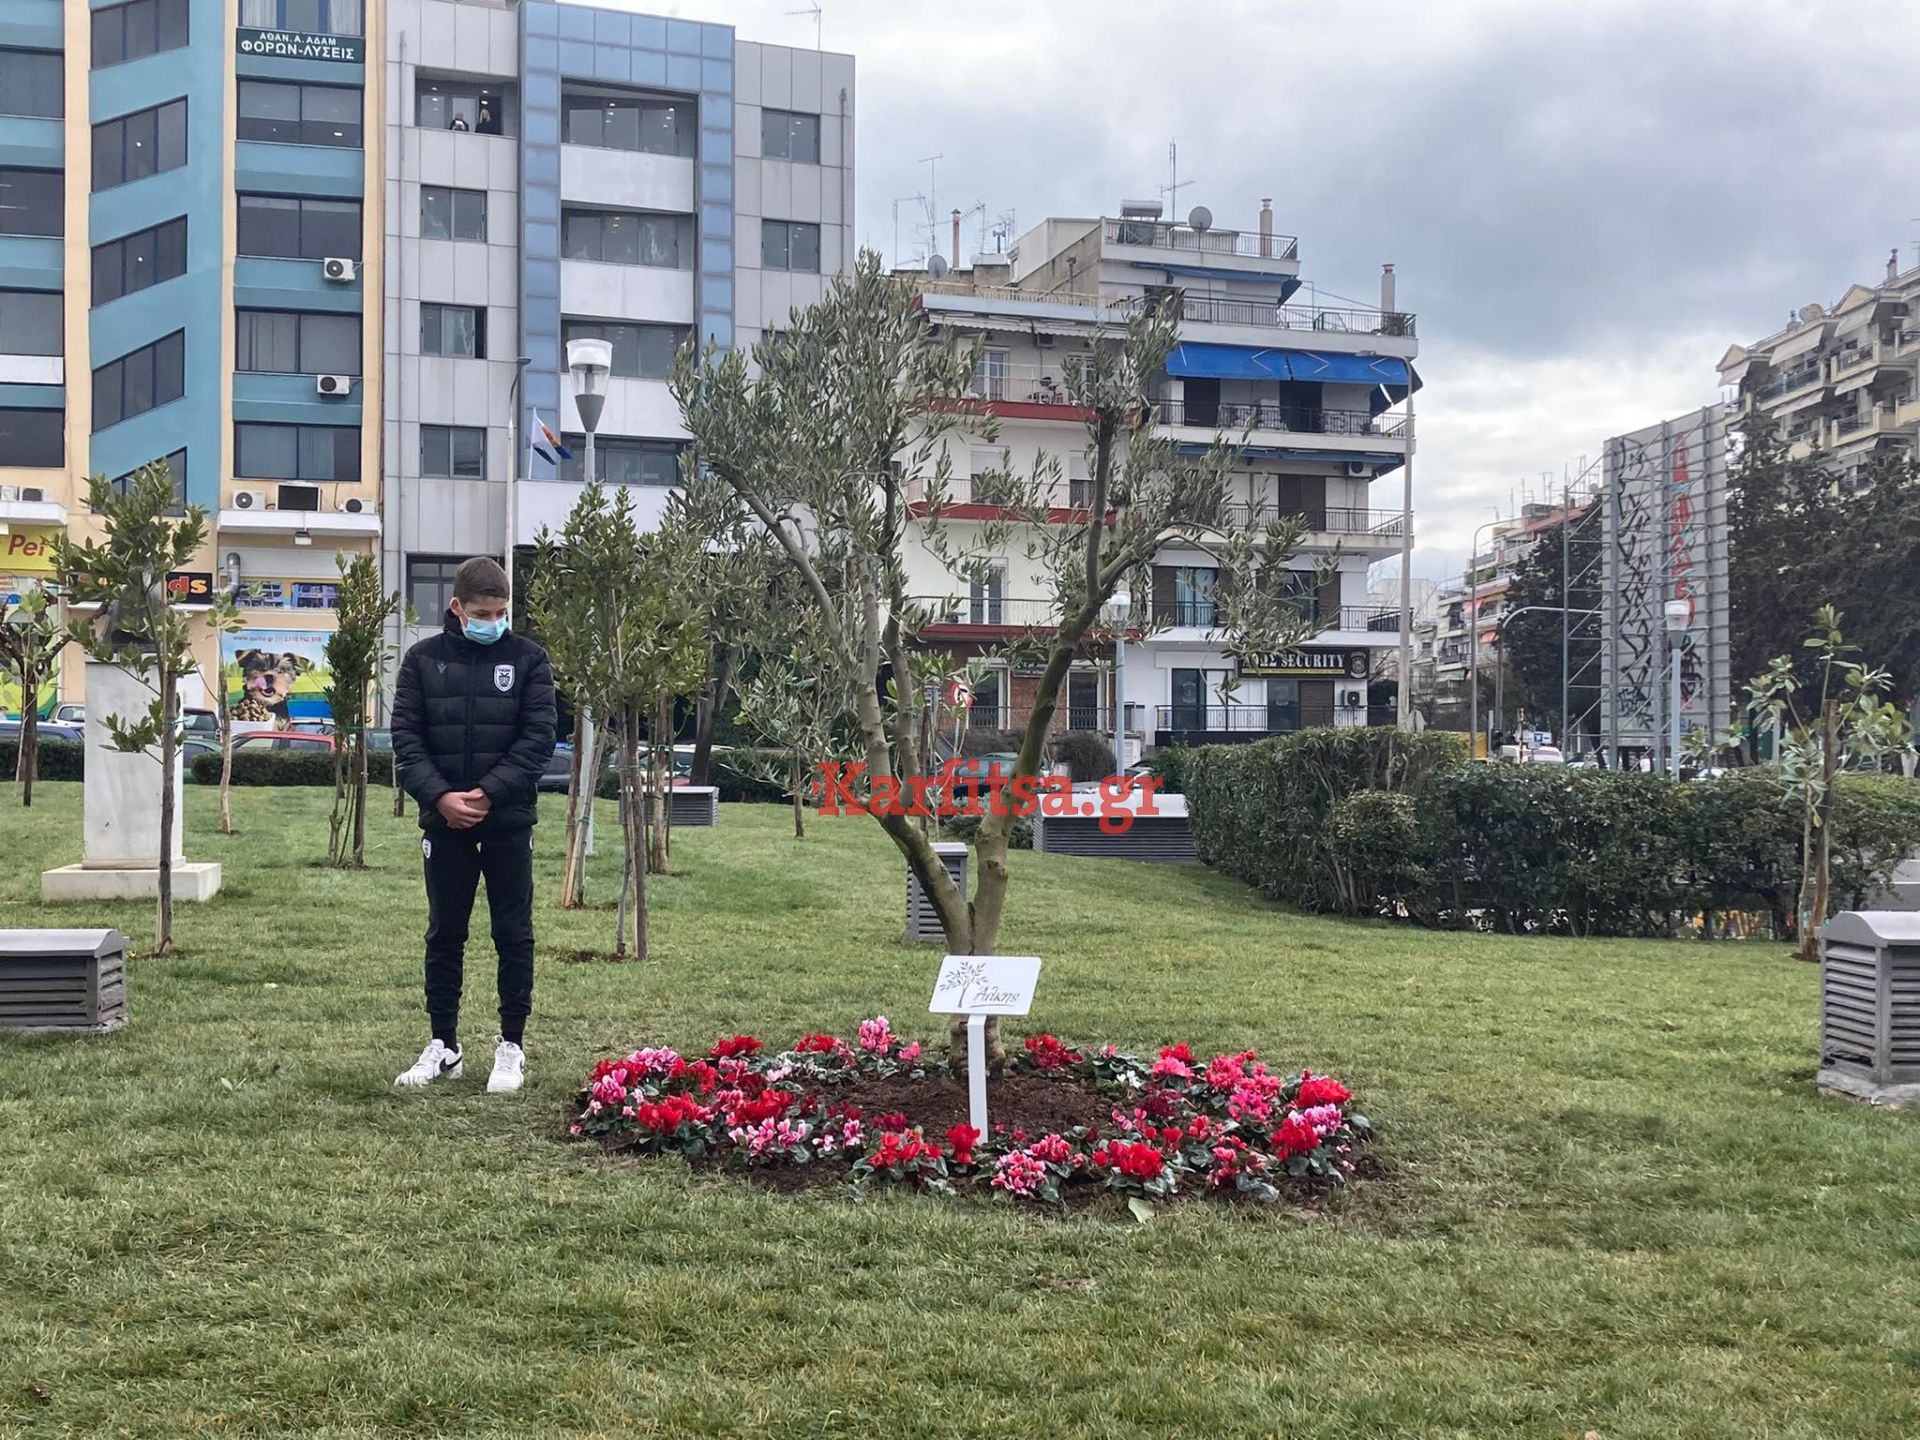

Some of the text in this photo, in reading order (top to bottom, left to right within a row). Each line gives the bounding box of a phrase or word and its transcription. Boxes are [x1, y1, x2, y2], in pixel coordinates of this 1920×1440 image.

[306, 36, 336, 46] ΑΔΑΜ
[241, 40, 354, 60] ΦΟΡΩΝ-ΛΥΣΕΙΣ
[1281, 654, 1345, 668] SECURITY
